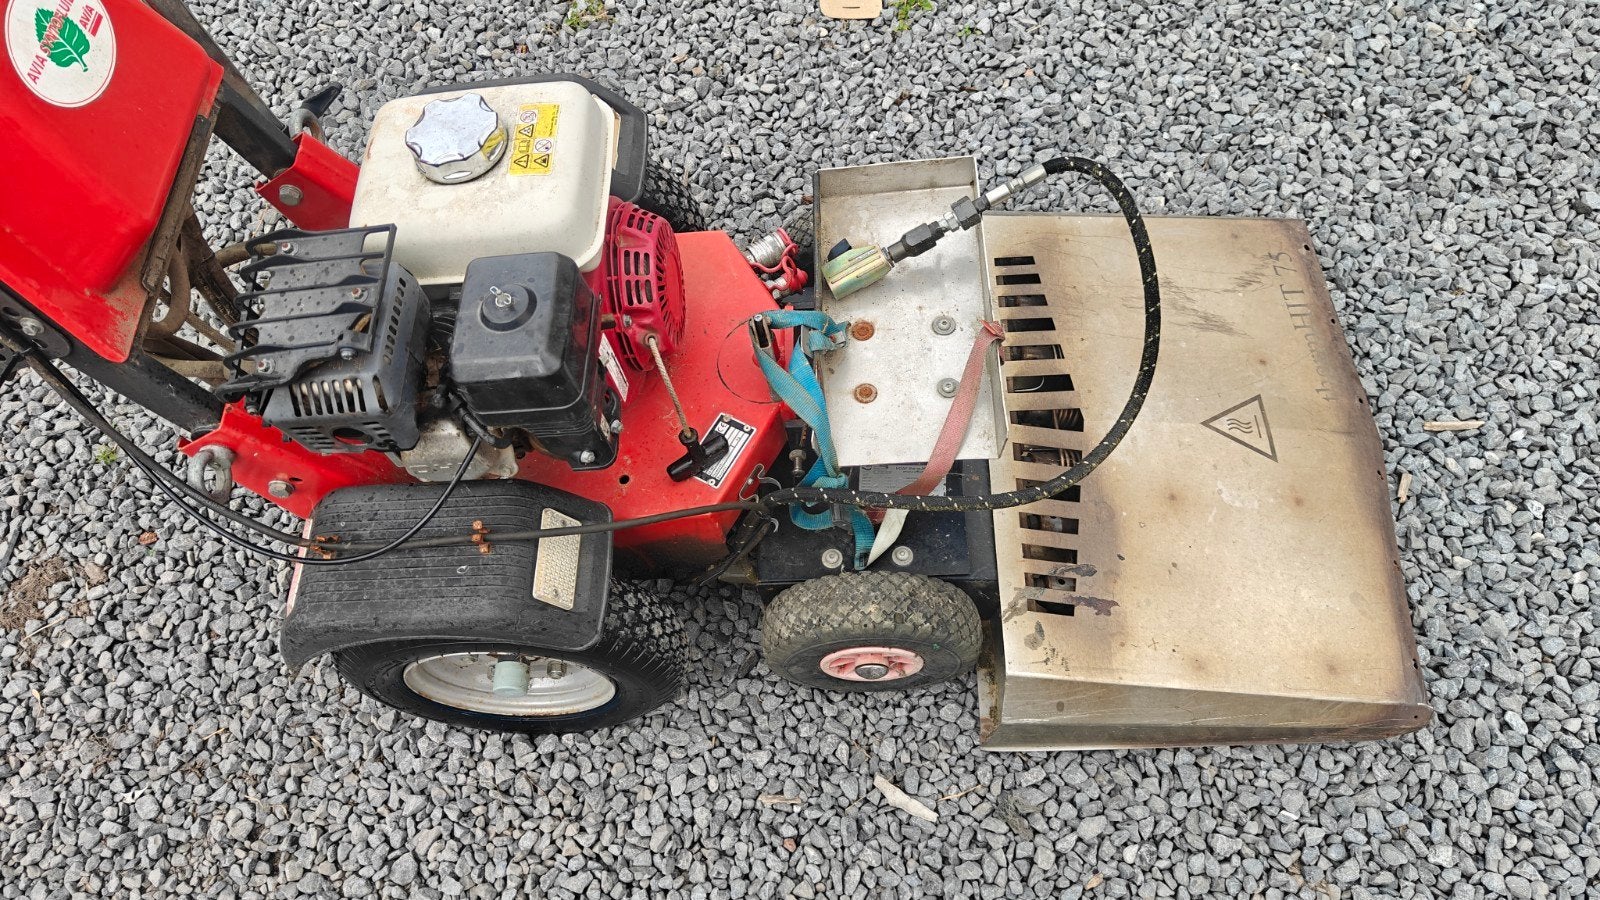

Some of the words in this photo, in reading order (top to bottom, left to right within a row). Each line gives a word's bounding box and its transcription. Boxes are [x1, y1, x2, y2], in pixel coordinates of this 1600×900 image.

[79, 4, 95, 29] AVIA
[27, 54, 48, 85] AVIA
[40, 0, 75, 57] SYNTOFLUI
[1268, 251, 1298, 277] 75
